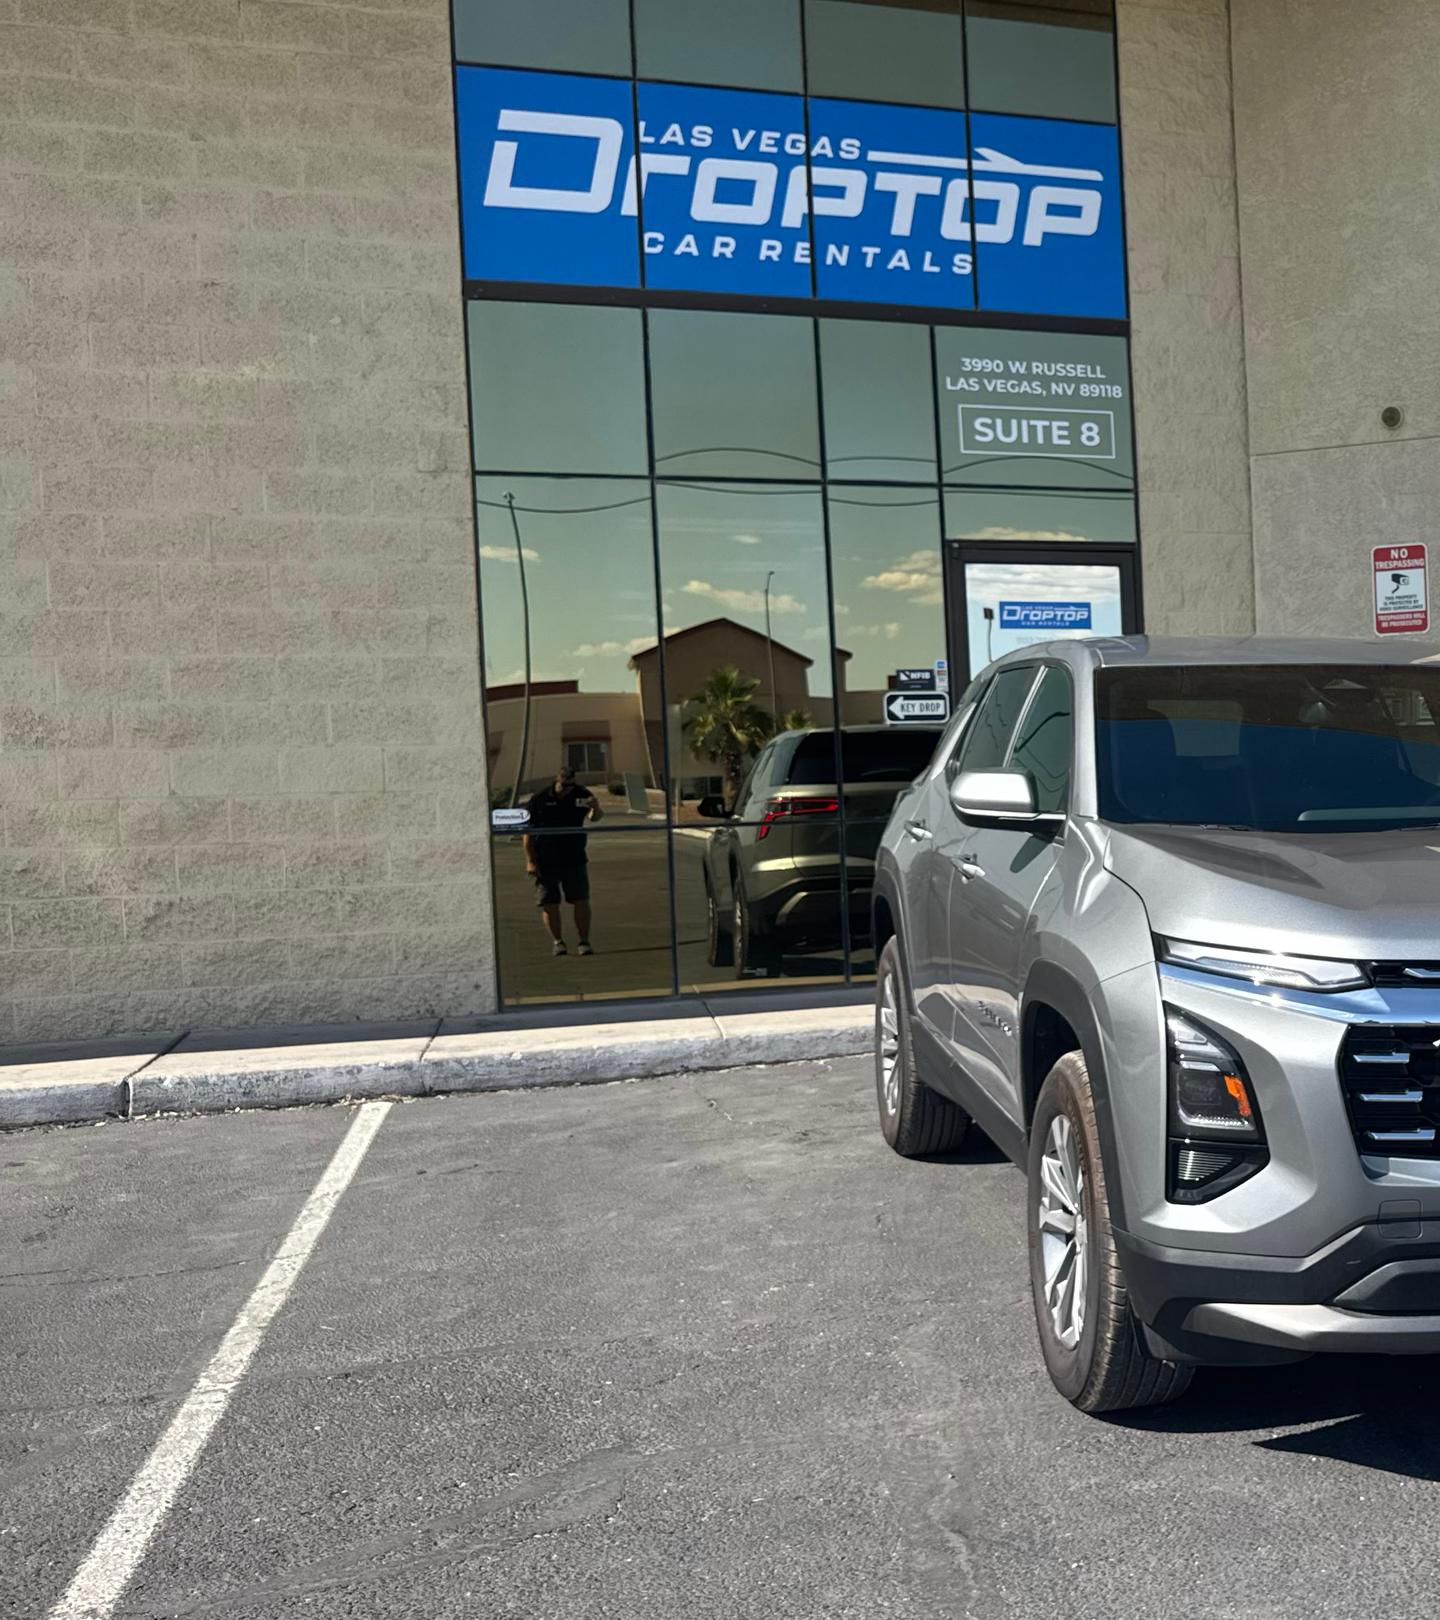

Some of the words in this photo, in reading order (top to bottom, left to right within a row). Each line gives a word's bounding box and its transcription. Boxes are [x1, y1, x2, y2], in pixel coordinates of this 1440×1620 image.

[639, 121, 713, 147] LAS
[732, 128, 861, 159] VEGAS
[643, 231, 736, 258] CAR
[759, 239, 974, 275] RENTALS
[961, 358, 1004, 373] 3990
[1032, 363, 1106, 379] RUSSELL
[946, 377, 979, 392] LAS
[984, 379, 1047, 397] VEGAS,
[1051, 382, 1075, 396] NV
[1080, 384, 1122, 398] 89118
[973, 417, 1071, 445] SUITE
[1080, 422, 1101, 447] 8
[1375, 558, 1425, 570] TRESPASSING
[1390, 548, 1408, 559] NO
[901, 703, 916, 712] KEY
[919, 703, 941, 712] DROP
